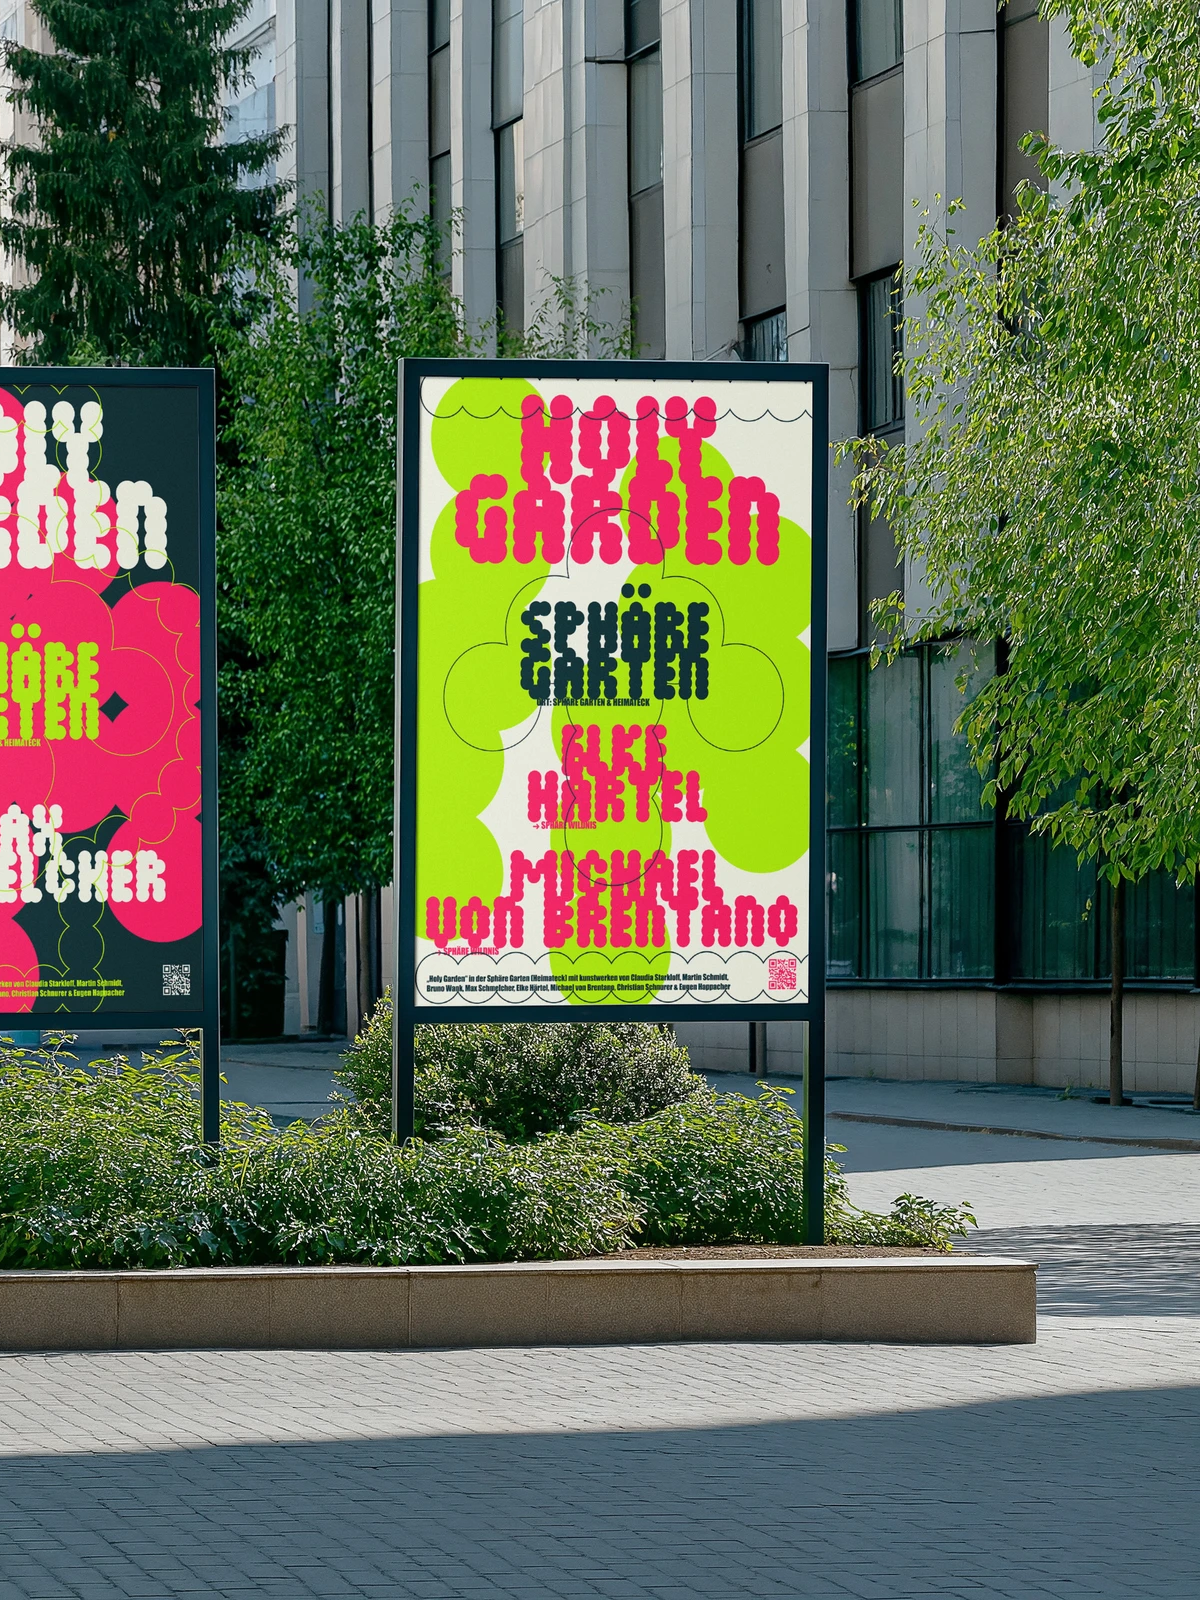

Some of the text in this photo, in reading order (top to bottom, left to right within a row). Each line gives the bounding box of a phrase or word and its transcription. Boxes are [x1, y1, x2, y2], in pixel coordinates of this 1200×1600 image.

[520, 394, 717, 486] HOLY
[455, 473, 780, 565] GARDEN
[520, 583, 709, 662] SPHÄRE
[520, 648, 709, 700] GARTEN
[510, 849, 723, 904] MICHAEL
